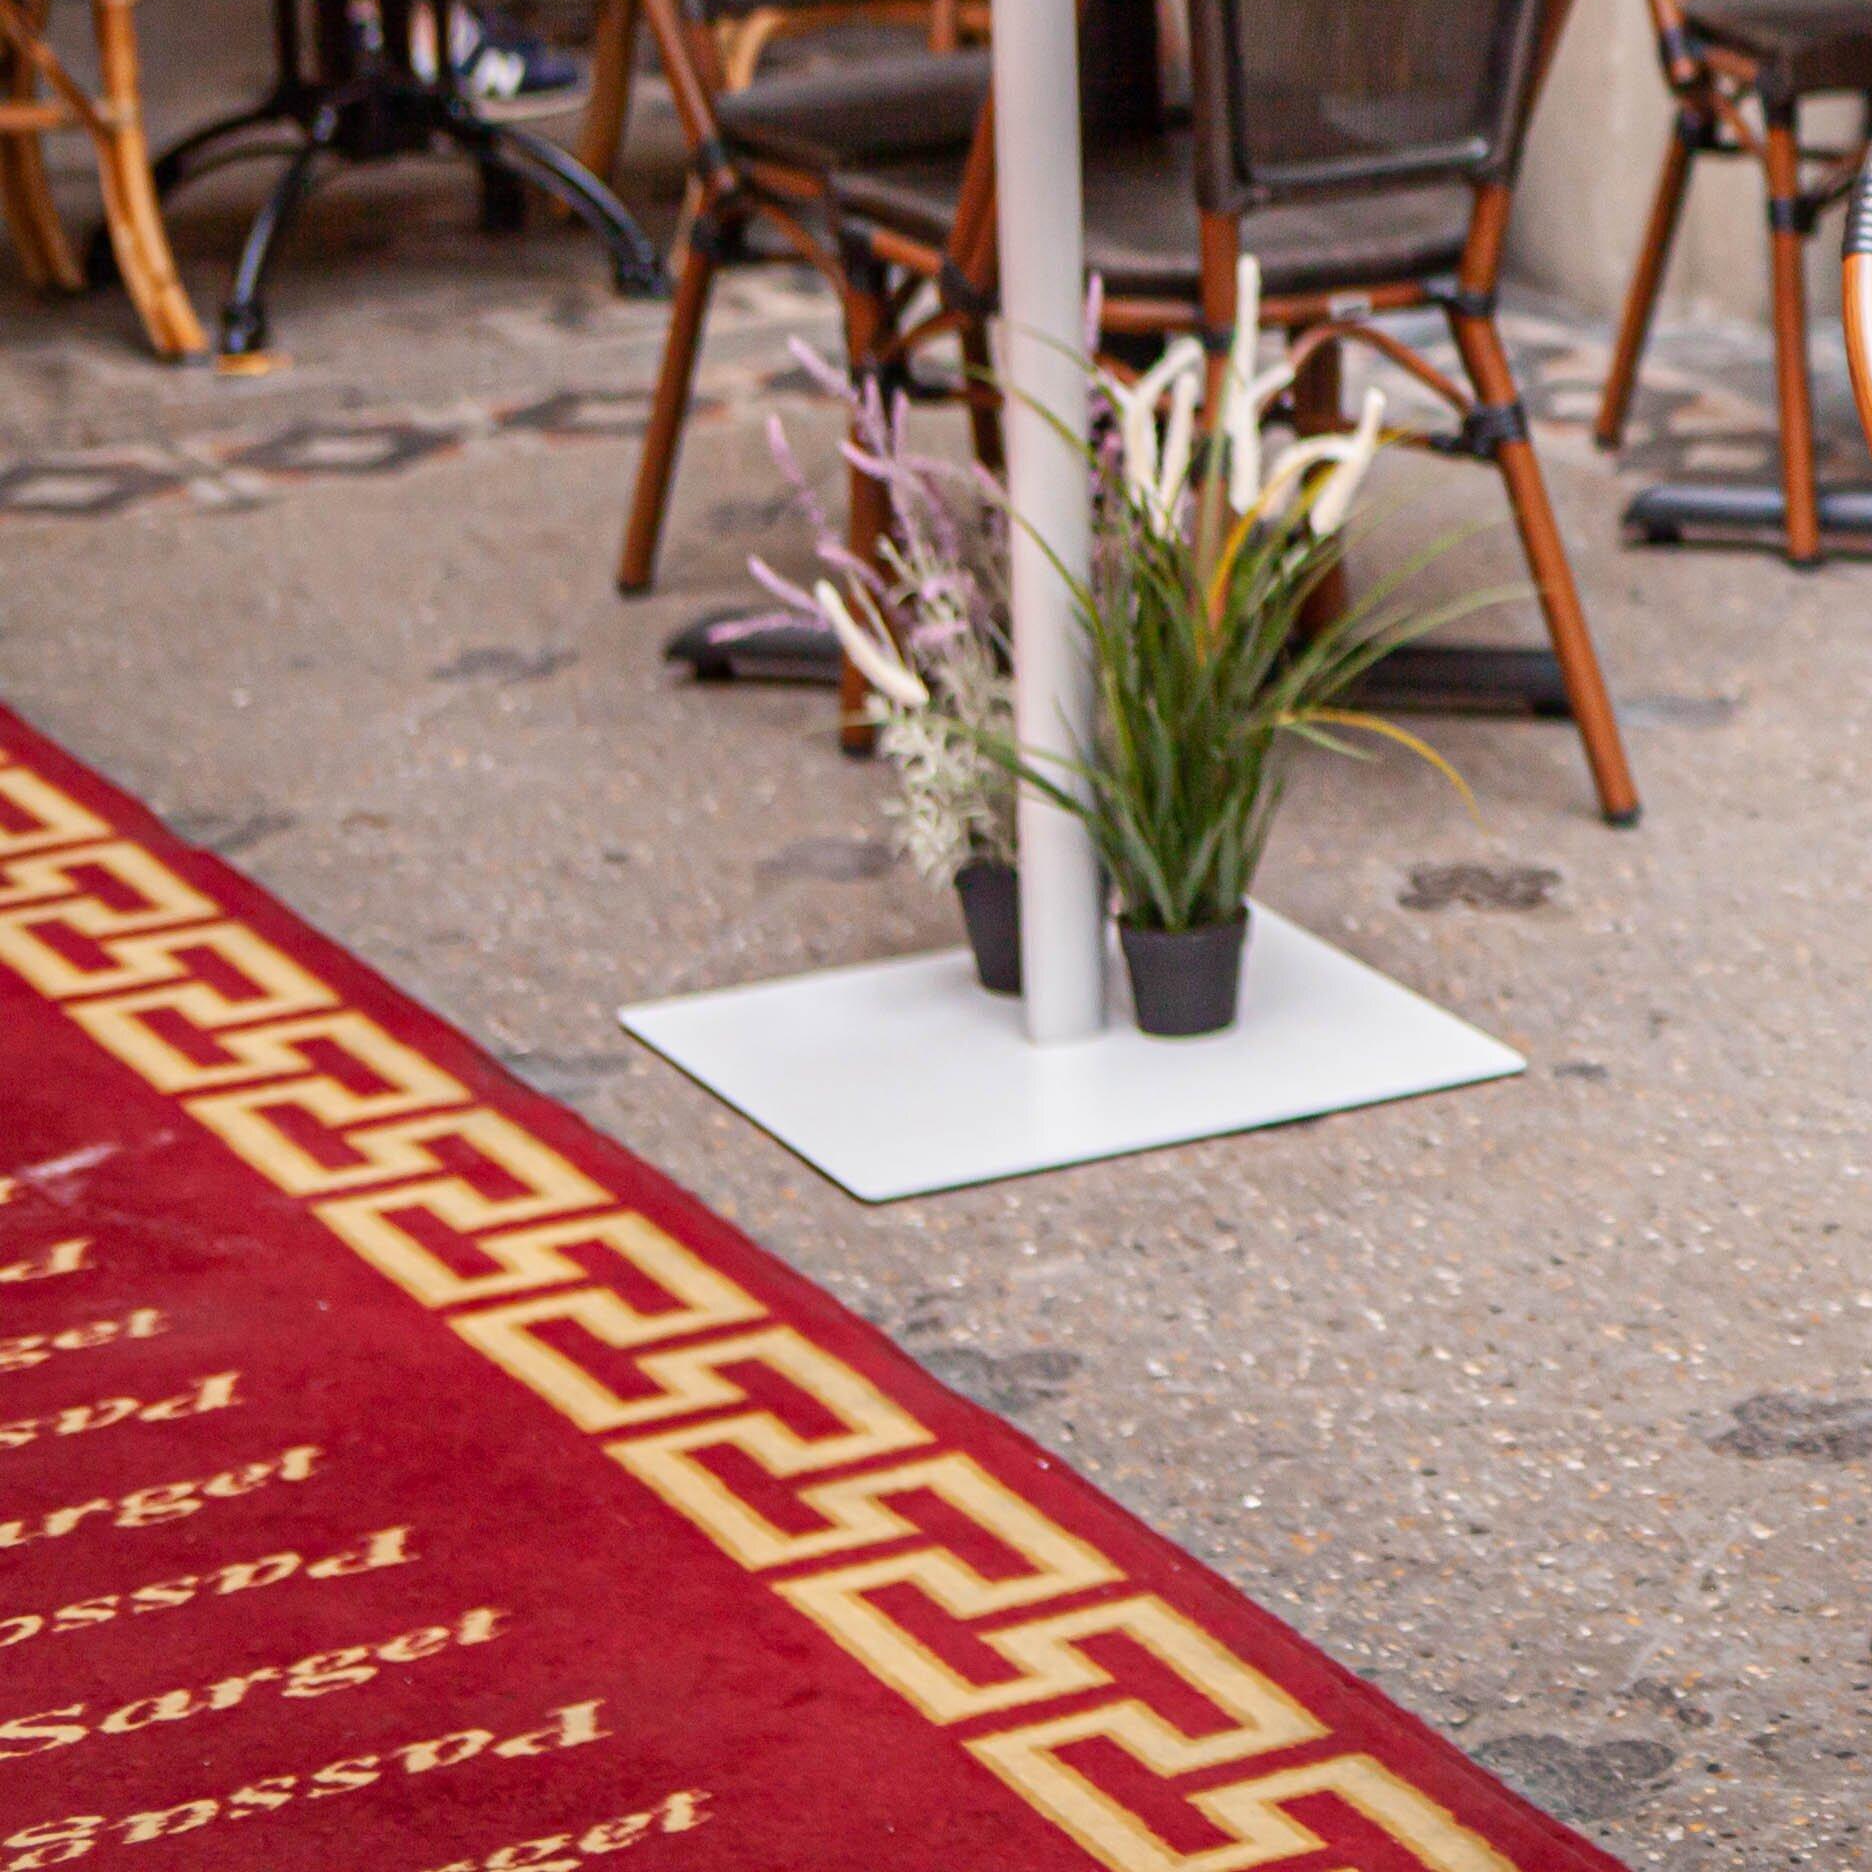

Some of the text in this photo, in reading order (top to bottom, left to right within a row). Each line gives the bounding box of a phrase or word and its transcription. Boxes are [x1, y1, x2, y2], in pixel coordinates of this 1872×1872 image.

[0, 1308, 170, 1373] get
[0, 1445, 325, 1549] rget
[0, 1527, 421, 1648] Pass
[0, 1608, 512, 1760] Sarget
[0, 1699, 614, 1872] Passag
